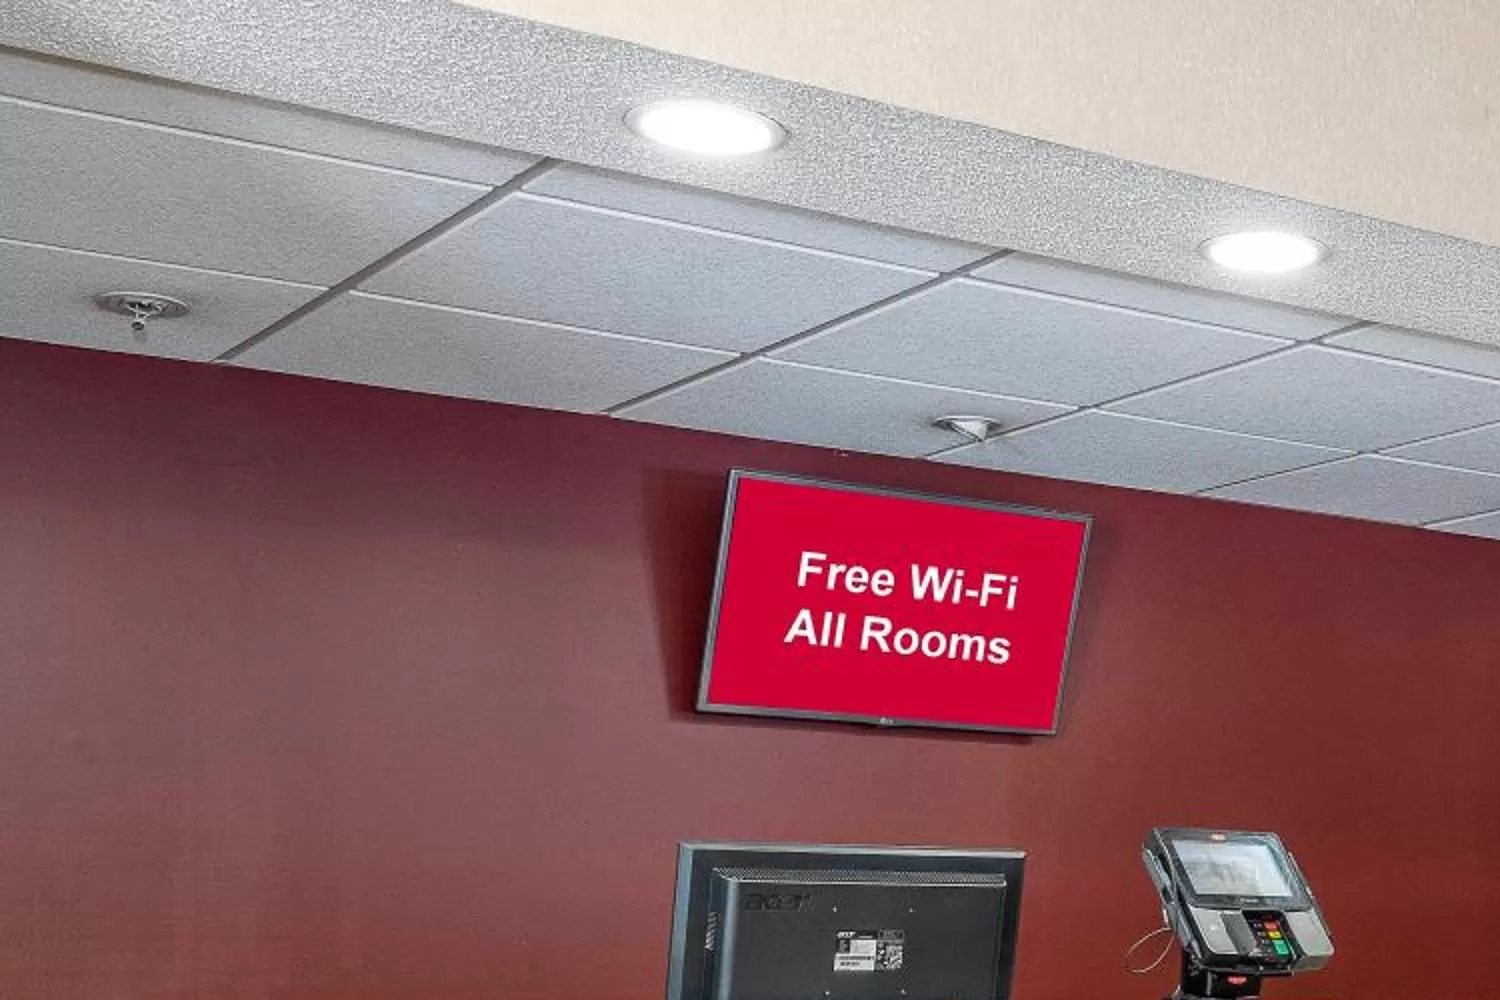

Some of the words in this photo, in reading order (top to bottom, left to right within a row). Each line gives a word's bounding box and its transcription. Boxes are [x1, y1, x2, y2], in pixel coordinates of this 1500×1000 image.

[797, 551, 895, 597] Free
[911, 563, 1019, 610] Wi-Fi
[783, 608, 847, 648] All
[860, 615, 1011, 665] Rooms
